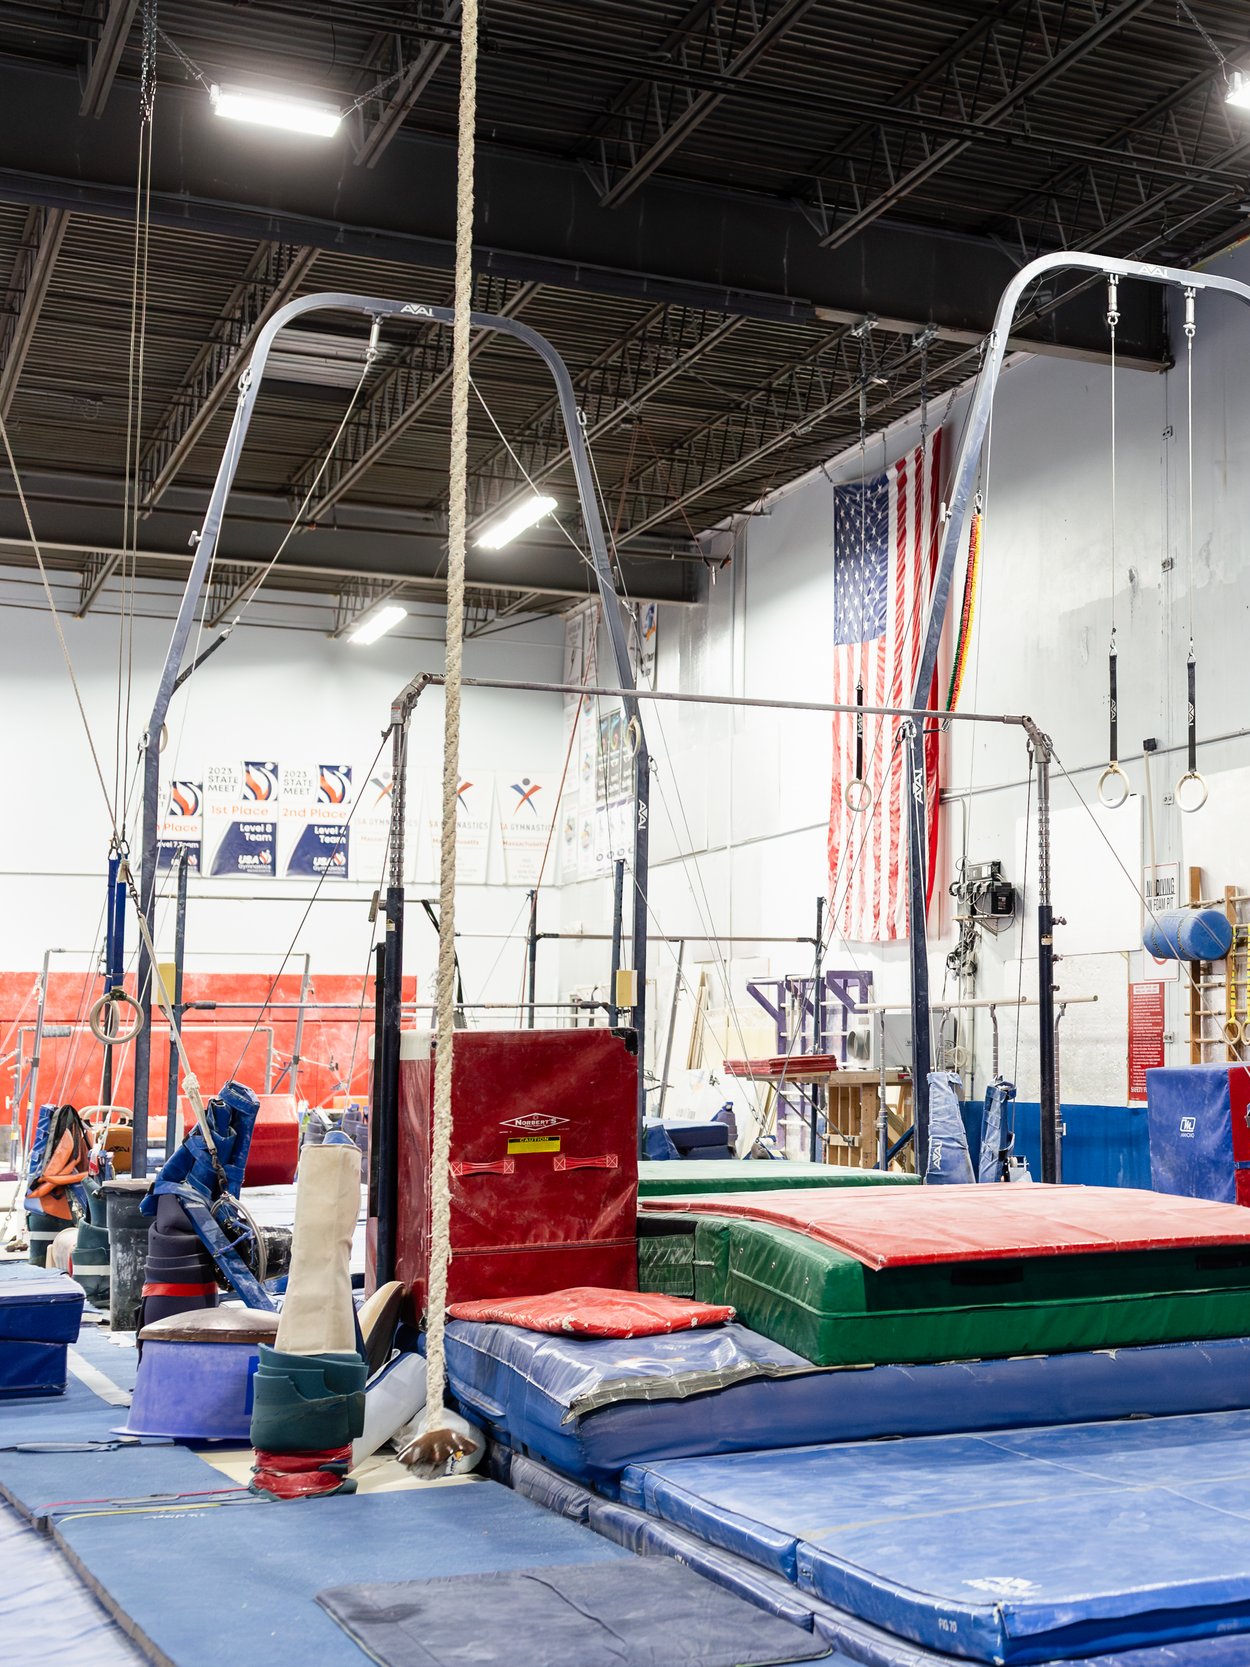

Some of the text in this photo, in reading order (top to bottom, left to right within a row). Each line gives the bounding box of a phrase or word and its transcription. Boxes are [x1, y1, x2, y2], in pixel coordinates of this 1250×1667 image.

[208, 767, 233, 775] 2023
[284, 770, 308, 778] 2023
[208, 775, 238, 784] STATE
[283, 778, 313, 787] STATE
[207, 784, 236, 792] MEET
[283, 787, 310, 795] MEET
[211, 805, 269, 816] 1st Place
[282, 807, 346, 818] 2nd Place
[163, 822, 198, 832] Place
[239, 823, 265, 832] Level
[314, 826, 338, 835] Level
[244, 832, 272, 842] Team
[319, 835, 346, 844] Team
